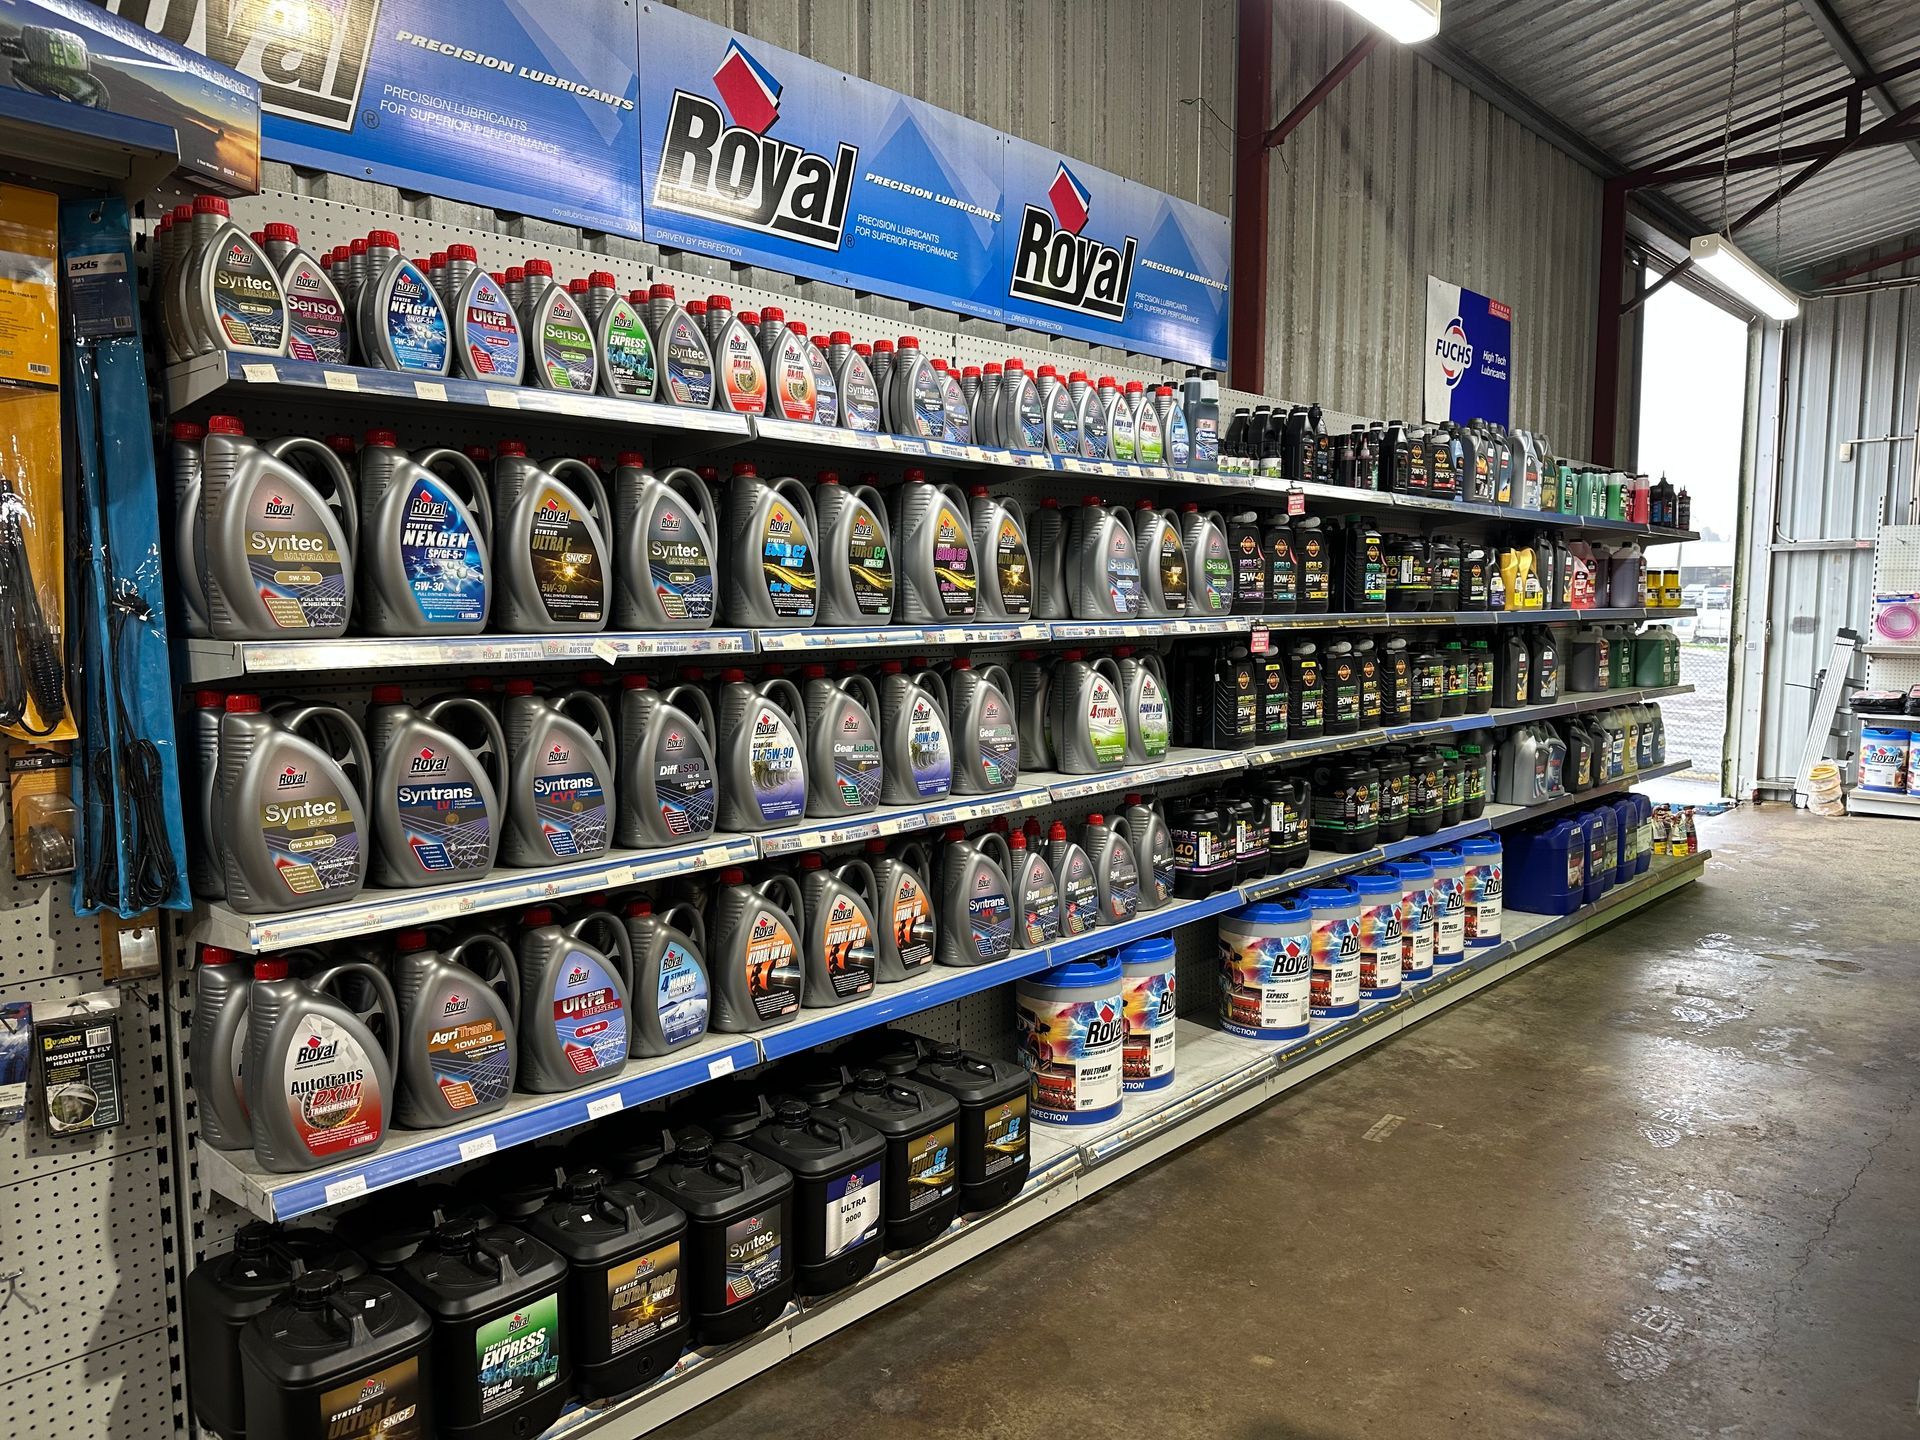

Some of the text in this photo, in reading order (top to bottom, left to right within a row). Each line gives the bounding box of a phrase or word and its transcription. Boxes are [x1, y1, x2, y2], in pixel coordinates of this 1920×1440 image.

[395, 29, 635, 112] PRECISION LUBRICANTS
[383, 84, 528, 132] PRECISION LUBRICANTS
[379, 100, 561, 156] FOR SUPERIOR PERFORMANCE
[654, 90, 858, 252] Royal
[864, 172, 1003, 226] PRECISION LUBRICANTS
[857, 213, 941, 247] PRECISION LUBRICANTS
[685, 236, 697, 249] BY
[698, 240, 743, 259] PERFECTION
[855, 226, 961, 265] FOR SUPERIOR PERFORMANCE
[70, 259, 99, 271] axis
[227, 250, 253, 265] Royal
[1011, 205, 1137, 318] Royal
[217, 270, 273, 292] Syntec
[1141, 258, 1229, 293] PRECISION LUBRICANTS
[287, 295, 336, 317] Senso
[391, 300, 438, 318] NEXGEN
[1135, 291, 1188, 312] PRECISION LUBRICANTS
[472, 309, 507, 328] Ultra
[1133, 301, 1201, 325] FOR SUPERIOR PERFORMANCE
[1030, 318, 1036, 326] BY
[1036, 320, 1063, 332] PERFECTION
[545, 325, 586, 342] Senso
[394, 337, 416, 348] 5W-30
[610, 334, 647, 349] EXPRESS
[670, 343, 705, 360] Syntec
[1435, 338, 1471, 365] FUCHS
[1483, 350, 1506, 366] High Tech
[1481, 364, 1507, 380] Lubricants
[847, 383, 874, 396] Syntec
[265, 502, 295, 517] Royal
[414, 498, 446, 517] Royal
[539, 506, 571, 525] Royal
[406, 522, 433, 530] SYNTEC
[769, 518, 793, 533] Royal
[854, 522, 873, 535] Royal
[939, 525, 956, 537] Royal
[250, 532, 323, 554] Syntec
[402, 531, 469, 549] NEXGEN
[532, 534, 572, 551] ULTRA F
[651, 541, 699, 557] Syntec
[792, 545, 806, 559] C2
[849, 545, 886, 560] EURO C4
[935, 547, 957, 560] EURO
[566, 553, 588, 563] SN/CF
[1110, 558, 1136, 571] Senso
[1206, 559, 1229, 571] Senso
[1239, 572, 1265, 582] 5W-40
[1274, 574, 1296, 584] 10W-50
[1306, 574, 1329, 583] 15W-60
[414, 581, 444, 592] 5W-30
[541, 582, 567, 593] 5W-30
[855, 583, 872, 592] 5W-30
[1093, 689, 1111, 702] Royal
[911, 708, 929, 721] Royal
[1089, 704, 1117, 718] 4 STROKE
[755, 720, 779, 734] Royal
[913, 730, 939, 743] 80W-90
[760, 747, 793, 760] 75W-90
[833, 741, 874, 754] GearLube
[15, 757, 43, 768] axis
[411, 755, 449, 773] Royal
[548, 751, 570, 764] Royal
[1871, 751, 1898, 765] Royal
[659, 763, 700, 777] Diff LS90
[279, 771, 307, 787] Royal
[534, 776, 594, 794] Syntrans
[399, 786, 473, 804] Syntrans
[551, 790, 577, 804] CVT
[265, 801, 337, 825] Syntec
[436, 801, 451, 811] LV
[1283, 819, 1308, 834] 5W-40
[291, 837, 335, 850] 5W-30 SN/CF
[1175, 844, 1194, 856] 40
[1210, 850, 1230, 863] 5W-40
[969, 897, 1005, 911] Syntrans
[831, 906, 855, 922] Royal
[753, 923, 778, 939] Royal
[1441, 924, 1457, 932] EXPRESS
[1415, 937, 1430, 945] EXPRESS
[1272, 953, 1310, 976] Roya
[1380, 953, 1397, 962] EXPRESS
[568, 969, 591, 985] Royal
[670, 968, 692, 979] STROKE
[1335, 970, 1353, 979] EXPRESS
[660, 976, 671, 993] 4
[669, 972, 698, 992] MARINE
[587, 988, 606, 998] EURO
[1266, 991, 1289, 999] EXPRESS
[562, 994, 606, 1015] Ultra
[664, 1011, 686, 1025] 10W-40
[430, 1020, 494, 1046] AgriTrans
[581, 1023, 602, 1034] 10W-40
[1087, 1018, 1122, 1048] Roya
[1222, 1022, 1257, 1037] PERFECTION
[454, 1034, 494, 1050] 10W-30
[45, 1044, 112, 1063] MOSQUITO & FLY
[53, 1052, 106, 1067] HEAD NETTING
[297, 1040, 338, 1064] Royal
[1081, 1049, 1107, 1058] PRECISION
[1081, 1064, 1112, 1077] MULTIFARM
[291, 1068, 364, 1096] Autotrans
[308, 1098, 359, 1117] TRANSMISSION
[910, 1147, 948, 1176] EURO C2
[840, 1196, 867, 1214] ULTRA
[845, 1211, 862, 1224] 9000
[730, 1230, 773, 1259] Syntec
[615, 1279, 638, 1294] SYNTEC
[611, 1282, 647, 1312] ULTRA
[481, 1327, 547, 1371] EXPRESS
[485, 1336, 514, 1353] TOPLINE
[482, 1379, 514, 1400] 15W-40
[327, 1401, 384, 1439] ULTRA
[331, 1404, 363, 1423] SYNTEC
